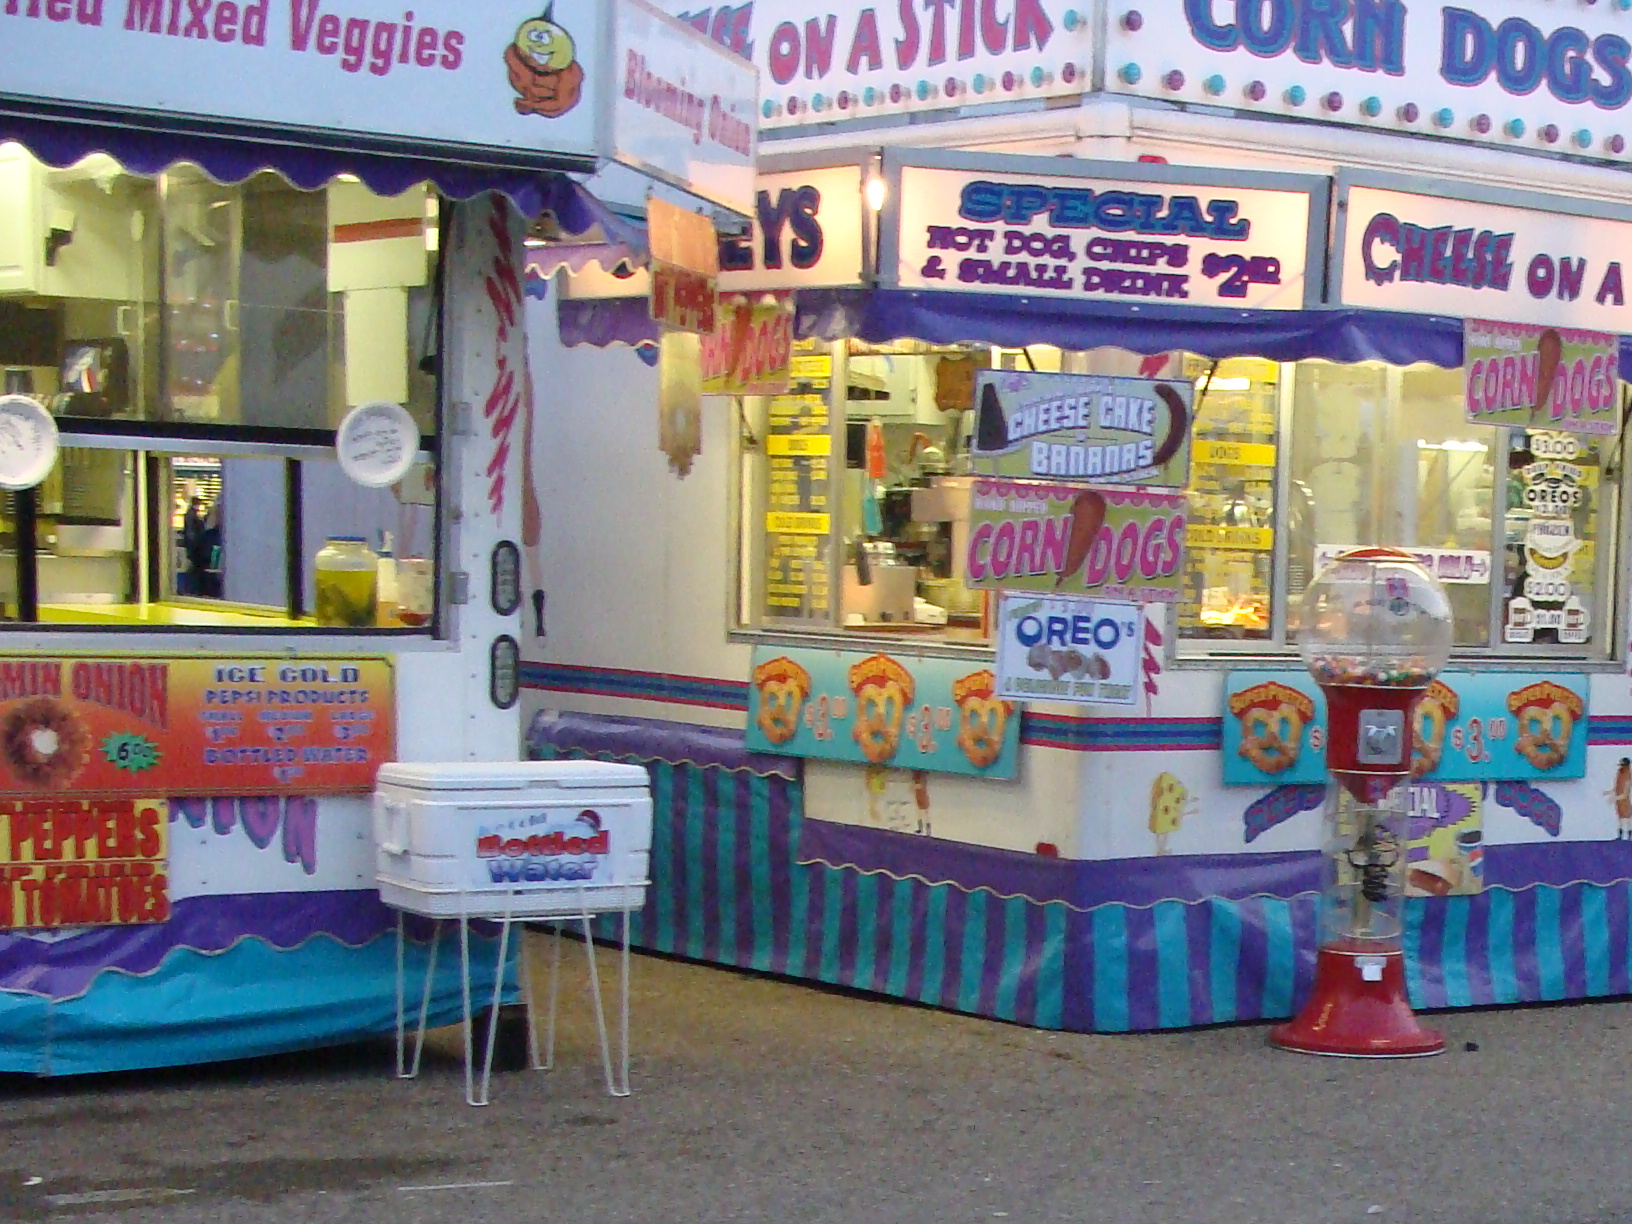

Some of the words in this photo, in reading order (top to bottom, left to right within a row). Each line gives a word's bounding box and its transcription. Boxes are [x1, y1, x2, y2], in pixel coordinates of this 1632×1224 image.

[124, 0, 267, 48] Mixed
[289, 0, 465, 77] Veggies
[769, 14, 837, 85] ON
[845, 8, 884, 76] A
[894, 0, 1055, 71] STICK
[1184, 0, 1406, 77] CORN
[958, 180, 1251, 241] SPECIAL
[926, 225, 995, 253] HOT
[1084, 236, 1190, 268] CHIPS
[1361, 212, 1517, 288] CHEESE
[1526, 252, 1587, 302] ON
[1595, 261, 1626, 306] A
[921, 255, 947, 280] &
[958, 257, 1073, 291] SMALL
[1082, 267, 1190, 299] DRINK
[1467, 351, 1541, 417] CORN
[1550, 352, 1618, 421] DOGS
[1007, 396, 1091, 443] CHEESE
[1099, 394, 1157, 437] CAKE
[1031, 438, 1154, 478] BANANAS
[1527, 488, 1583, 505] OREOS
[967, 513, 1075, 583] CORN
[1083, 514, 1187, 589] DOGS
[215, 664, 267, 683] ICE
[279, 663, 360, 684] COLD
[205, 689, 262, 705] PEPSI
[205, 747, 297, 765] BOTTLED
[10, 805, 160, 858] PEPPERS
[476, 829, 611, 859] Bottled
[486, 857, 600, 883] Water
